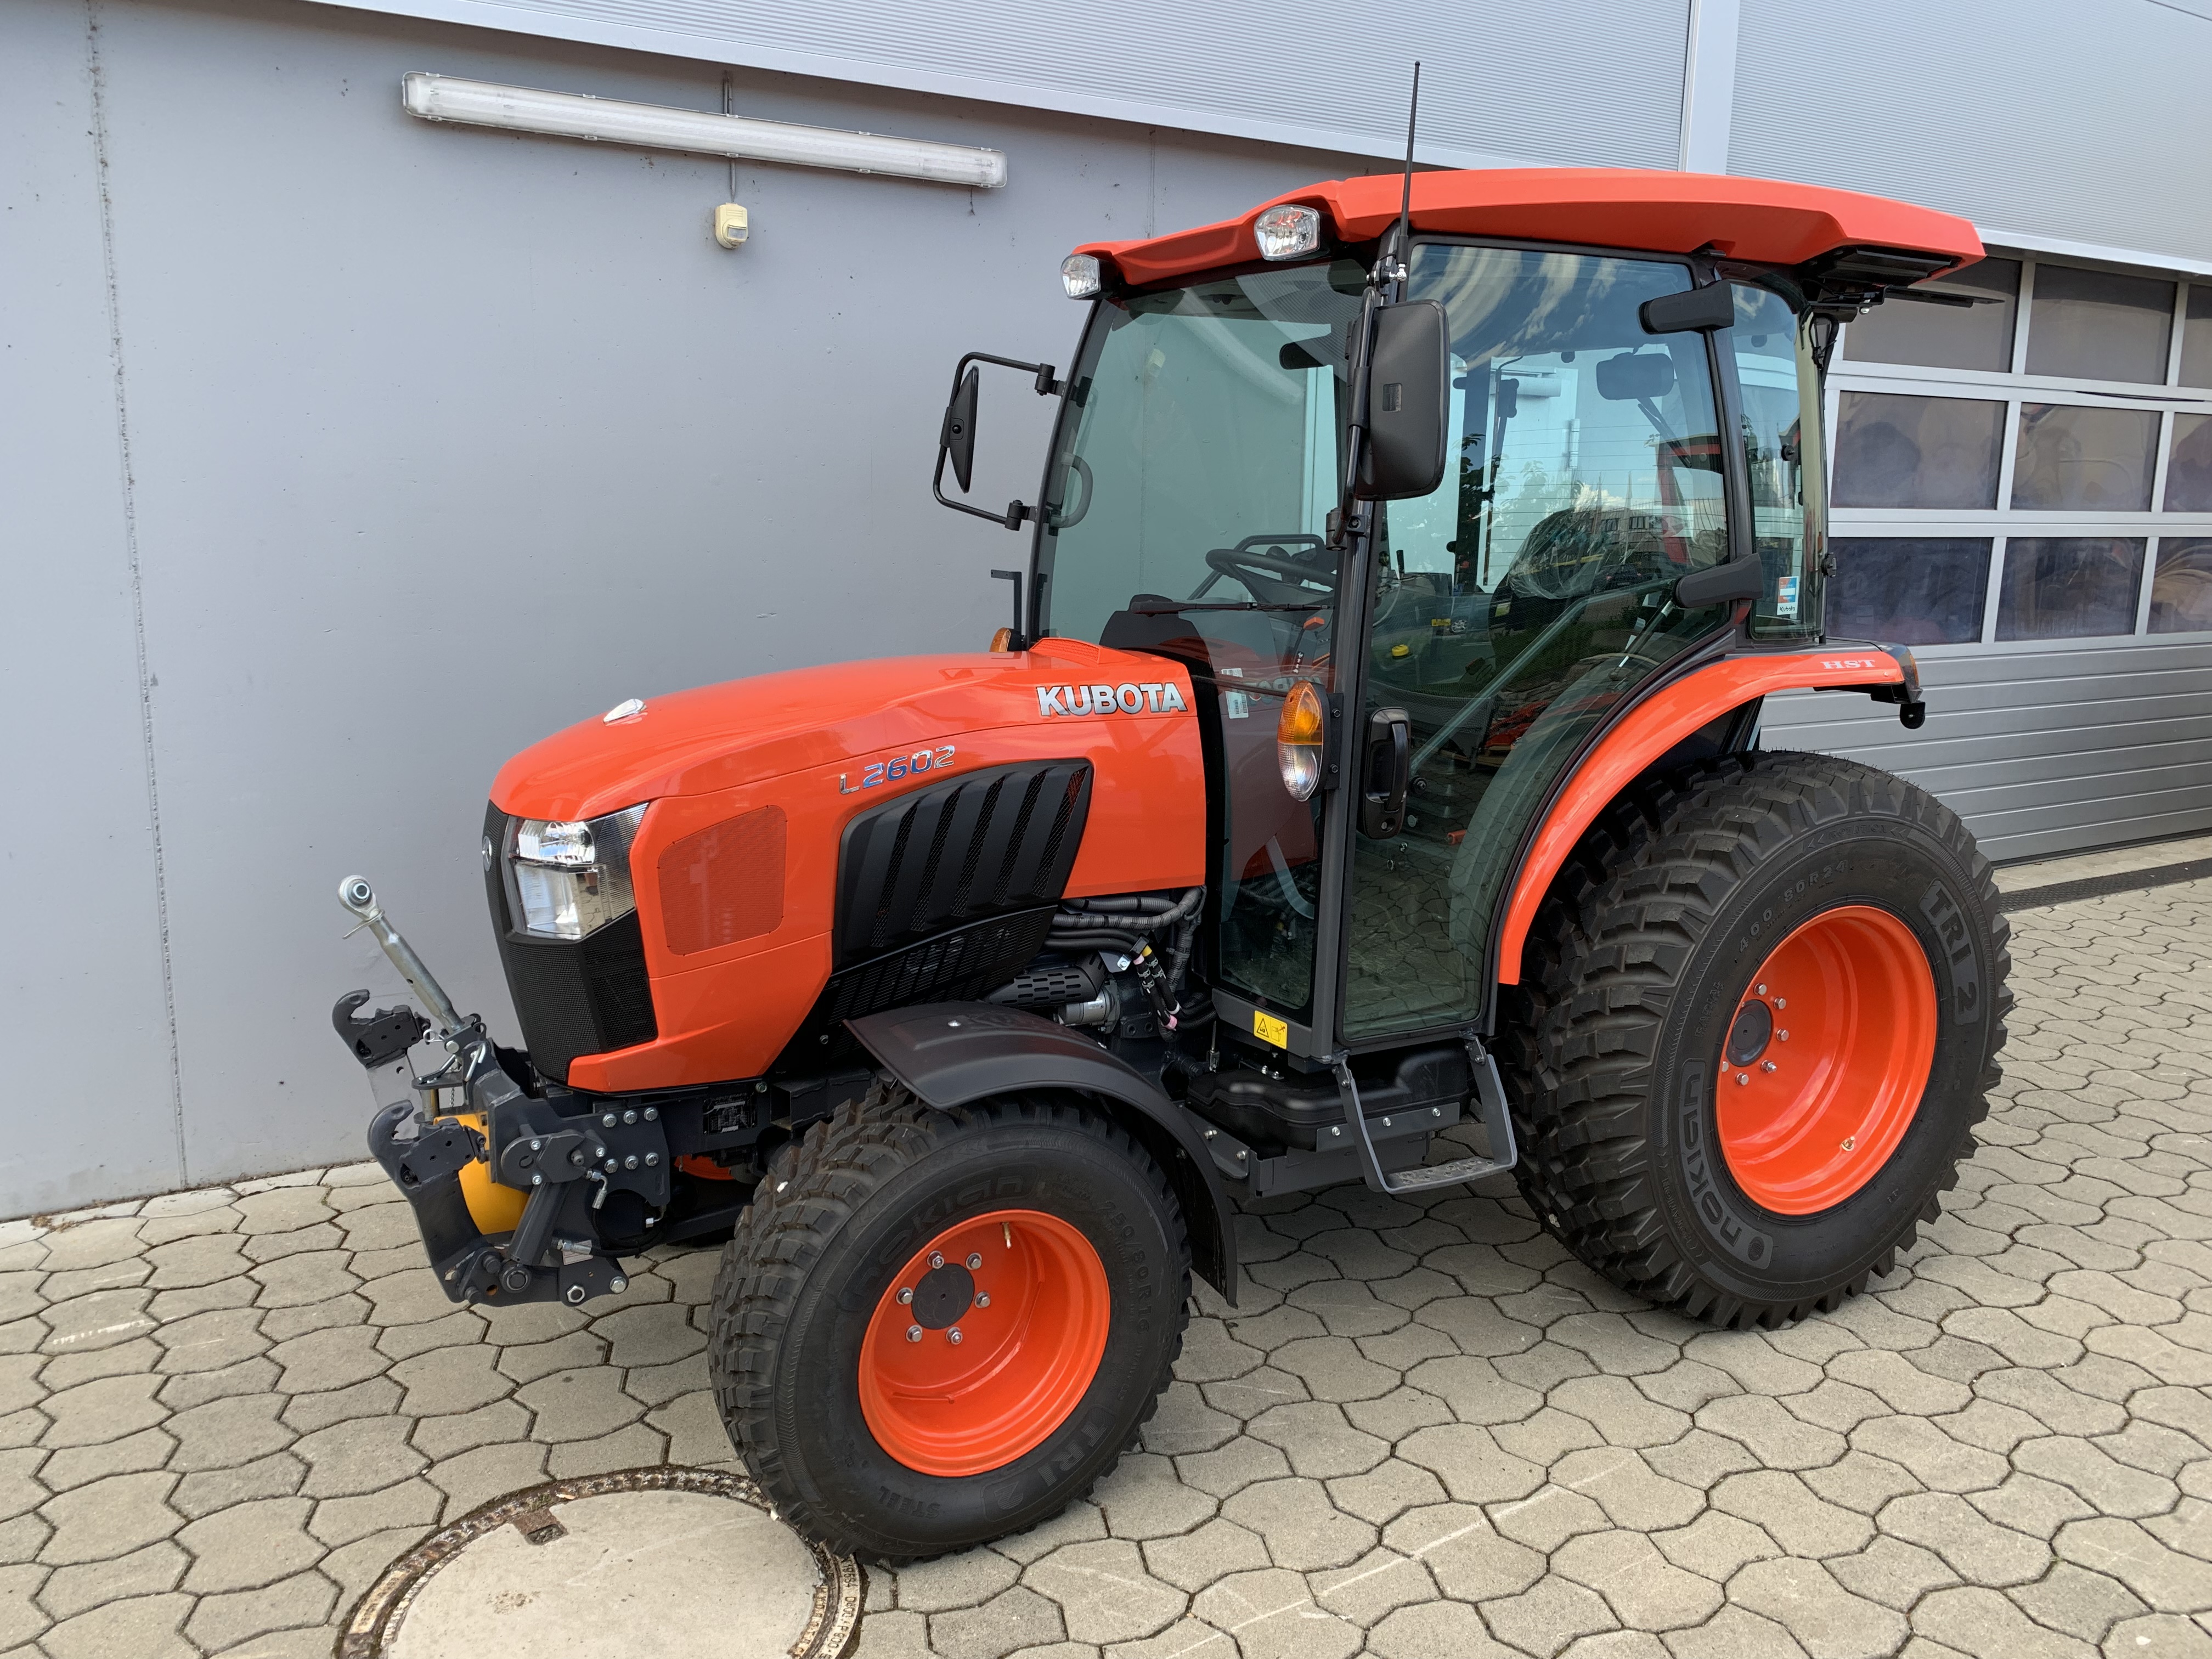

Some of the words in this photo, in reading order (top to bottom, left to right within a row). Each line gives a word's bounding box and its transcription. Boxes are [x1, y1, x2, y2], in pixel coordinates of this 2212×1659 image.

[1821, 660, 1875, 669] HST
[1036, 682, 1187, 716] KUBOTA
[839, 745, 956, 795] L2602
[1928, 887, 1972, 966] TRI
[1957, 982, 1976, 1014] 2
[879, 1487, 941, 1520] STEEL
